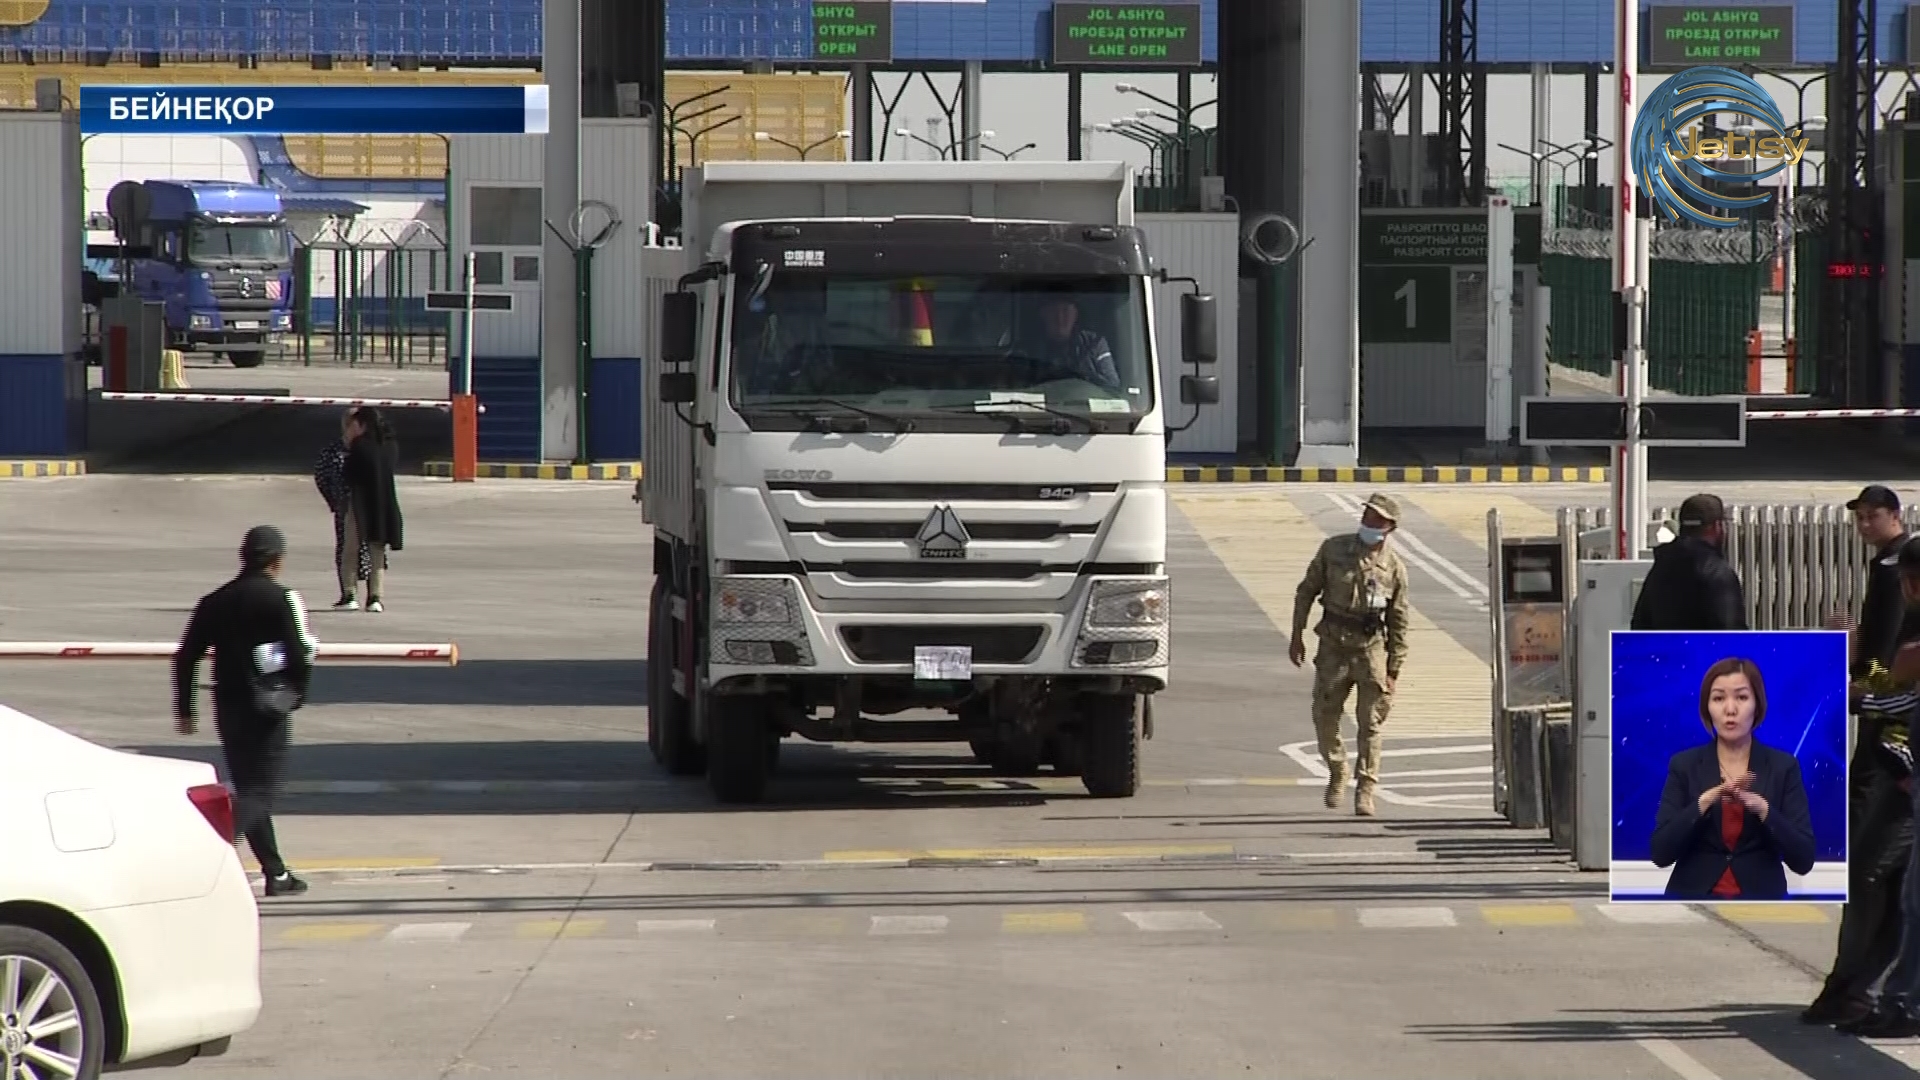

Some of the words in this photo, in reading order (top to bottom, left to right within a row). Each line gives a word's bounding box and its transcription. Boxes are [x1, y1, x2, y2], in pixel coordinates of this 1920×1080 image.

[1087, 9, 1113, 20] JOL
[1117, 9, 1165, 20] ASHYQ
[1684, 11, 1708, 22] JOL
[1713, 11, 1759, 22] ASHYQ
[819, 25, 877, 36] ОТКРЫТ
[1069, 27, 1125, 39] ПРОЕЗД
[1129, 27, 1187, 38] ОТКРЫТ
[1666, 29, 1720, 40] ПРОЕЗД
[1724, 29, 1780, 39] ОТКРЫТ
[819, 43, 857, 54] OPEN
[1088, 45, 1125, 56] LANE
[1129, 45, 1167, 56] OPEN
[1685, 46, 1720, 56] LANE
[1724, 46, 1761, 56] OPEN
[1380, 234, 1459, 245] ПАСПОРТНЫЙ
[1394, 247, 1451, 257] PASSPORT
[1394, 279, 1416, 328] 1
[1039, 487, 1075, 499] 340
